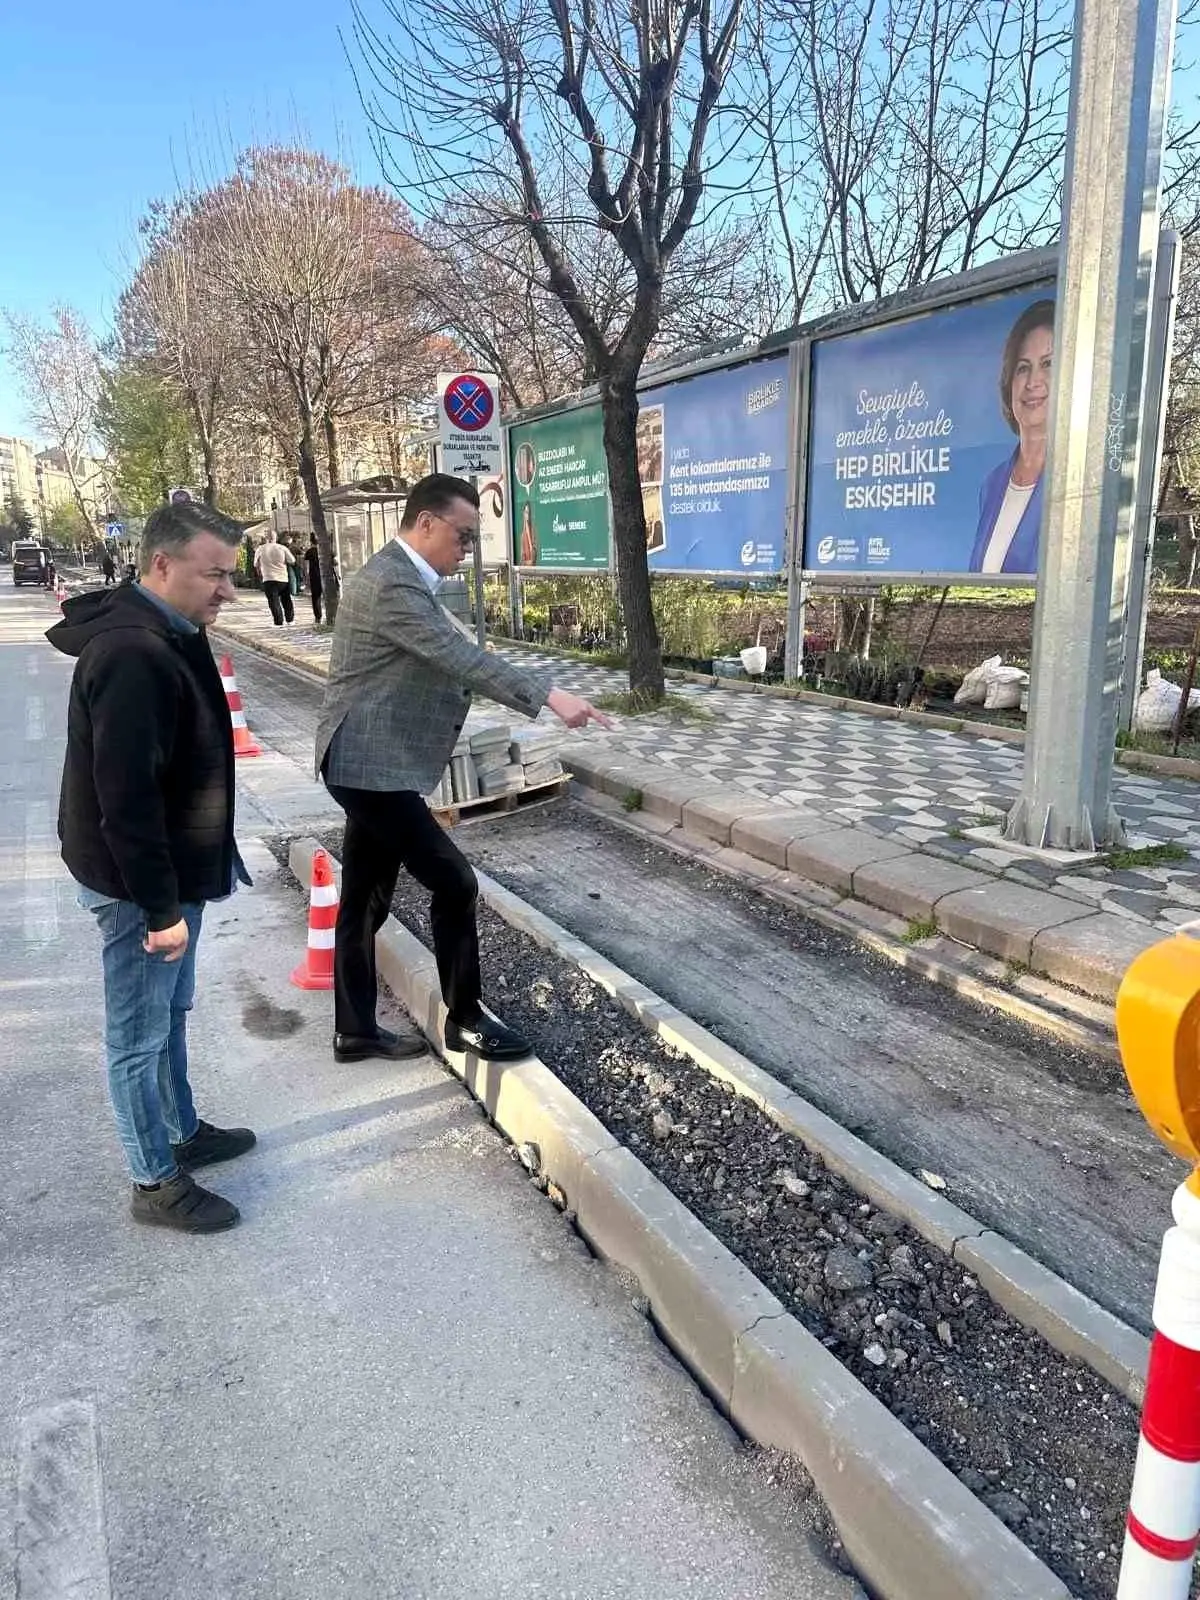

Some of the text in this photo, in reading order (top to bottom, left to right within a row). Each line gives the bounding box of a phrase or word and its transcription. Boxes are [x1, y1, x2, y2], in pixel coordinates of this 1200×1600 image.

[857, 381, 929, 421] Sevgiyle,
[836, 409, 953, 447] emekle, özenle
[670, 452, 772, 478] Kent lokantalarımız ile
[836, 456, 868, 480] HEP
[685, 481, 697, 495] bin
[699, 476, 770, 494] vatandaşımıza
[845, 476, 936, 511] ESKİŞEHİR
